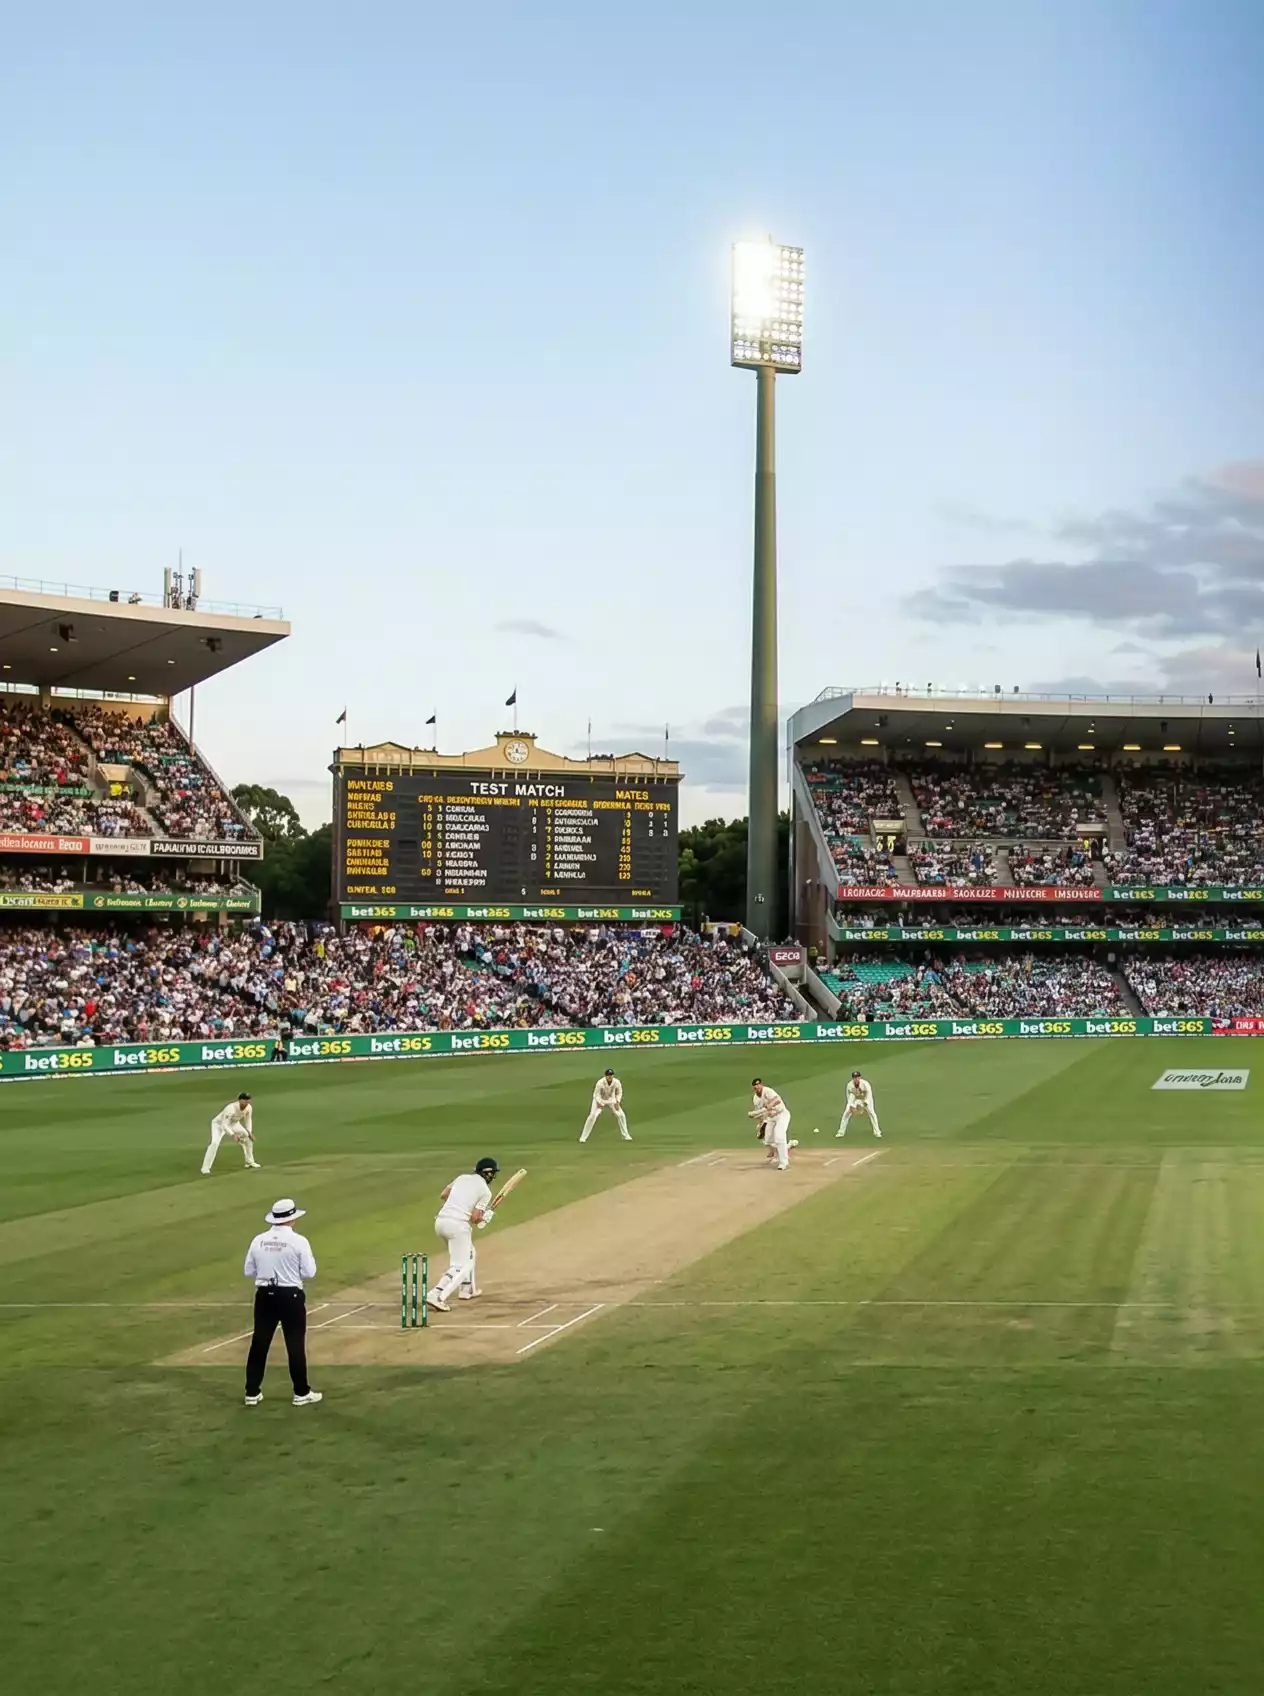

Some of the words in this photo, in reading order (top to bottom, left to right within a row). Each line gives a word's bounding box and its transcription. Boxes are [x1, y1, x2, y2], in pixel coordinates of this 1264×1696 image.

[470, 782, 508, 795] TEST
[515, 784, 565, 797] MATCH
[615, 790, 649, 800] MATES
[24, 1052, 93, 1070] bet365
